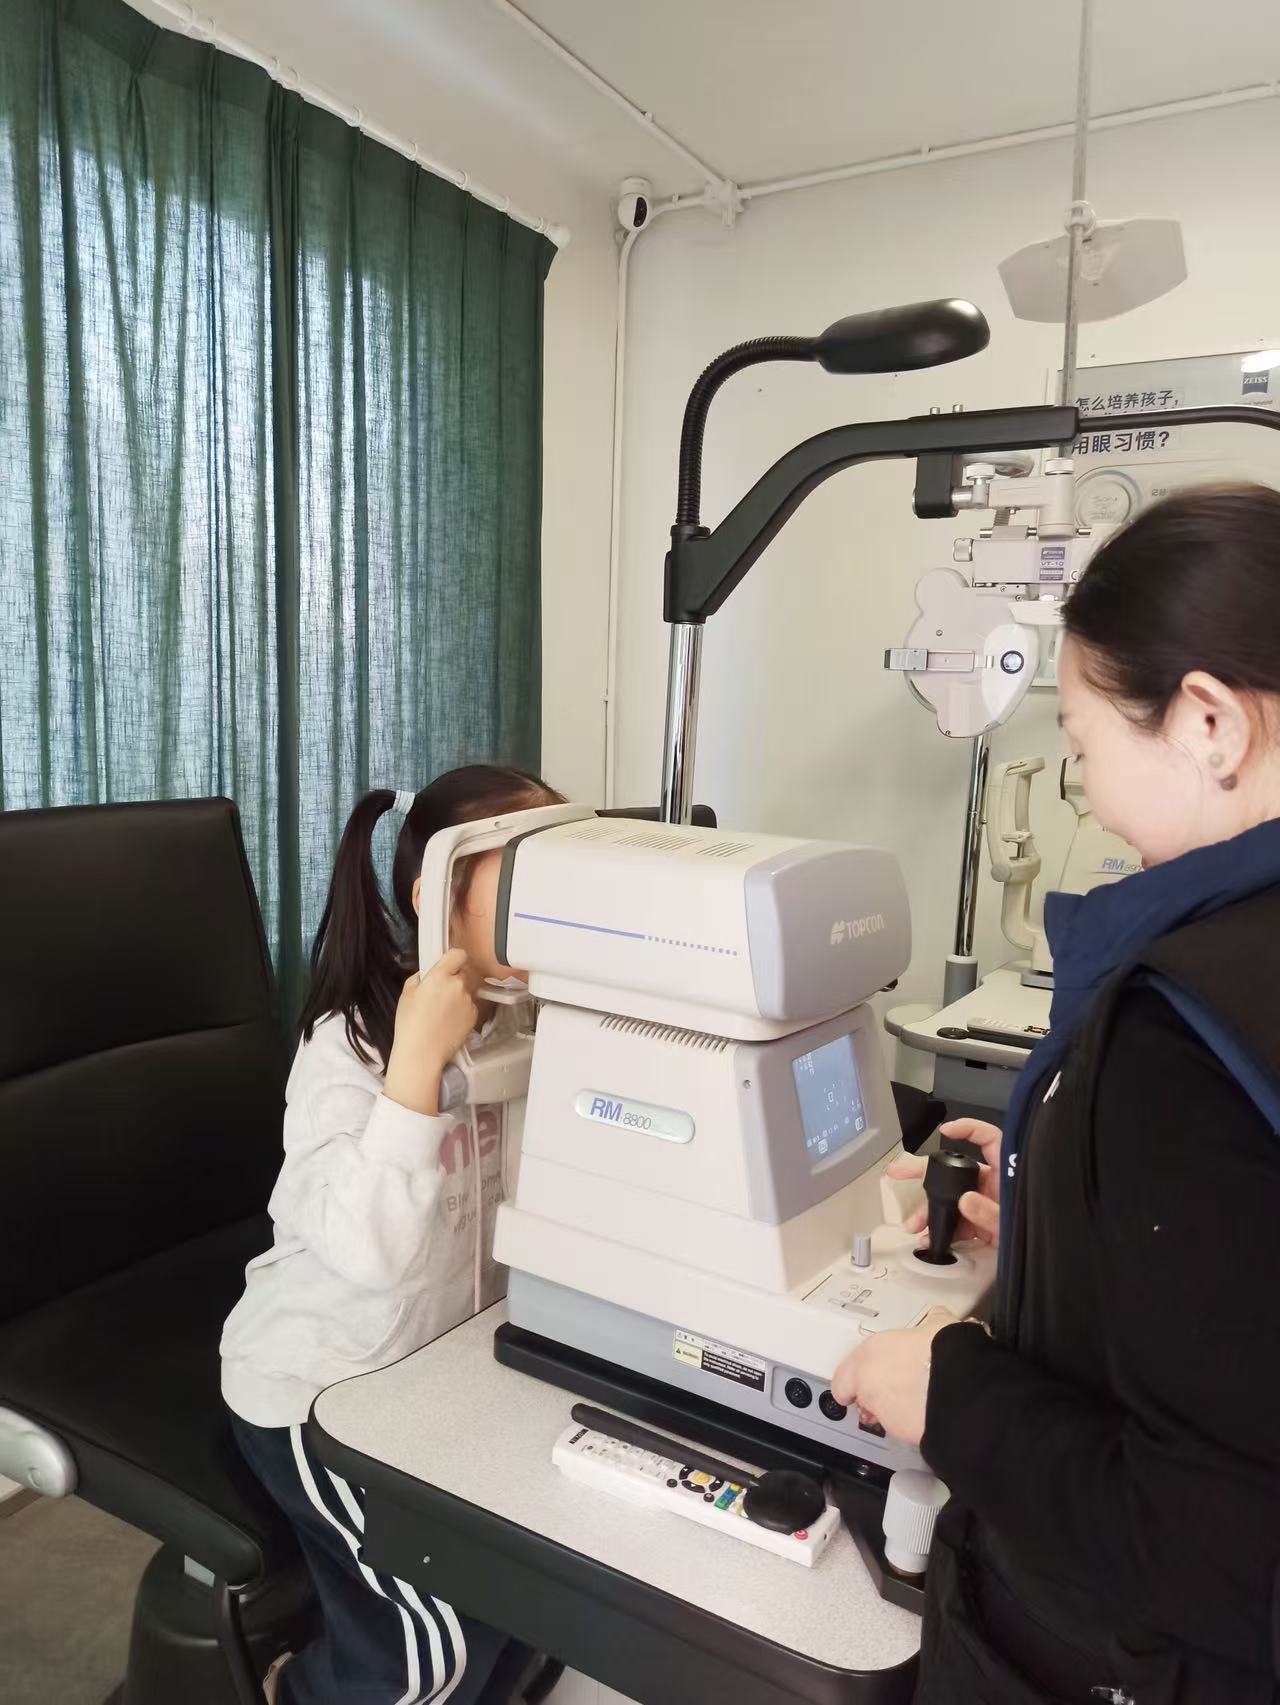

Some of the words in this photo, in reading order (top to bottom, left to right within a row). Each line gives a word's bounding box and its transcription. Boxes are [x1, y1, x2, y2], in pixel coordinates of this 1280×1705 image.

[846, 914, 885, 940] TOPCON
[589, 1097, 623, 1121] RM
[623, 1112, 652, 1129] 8800
